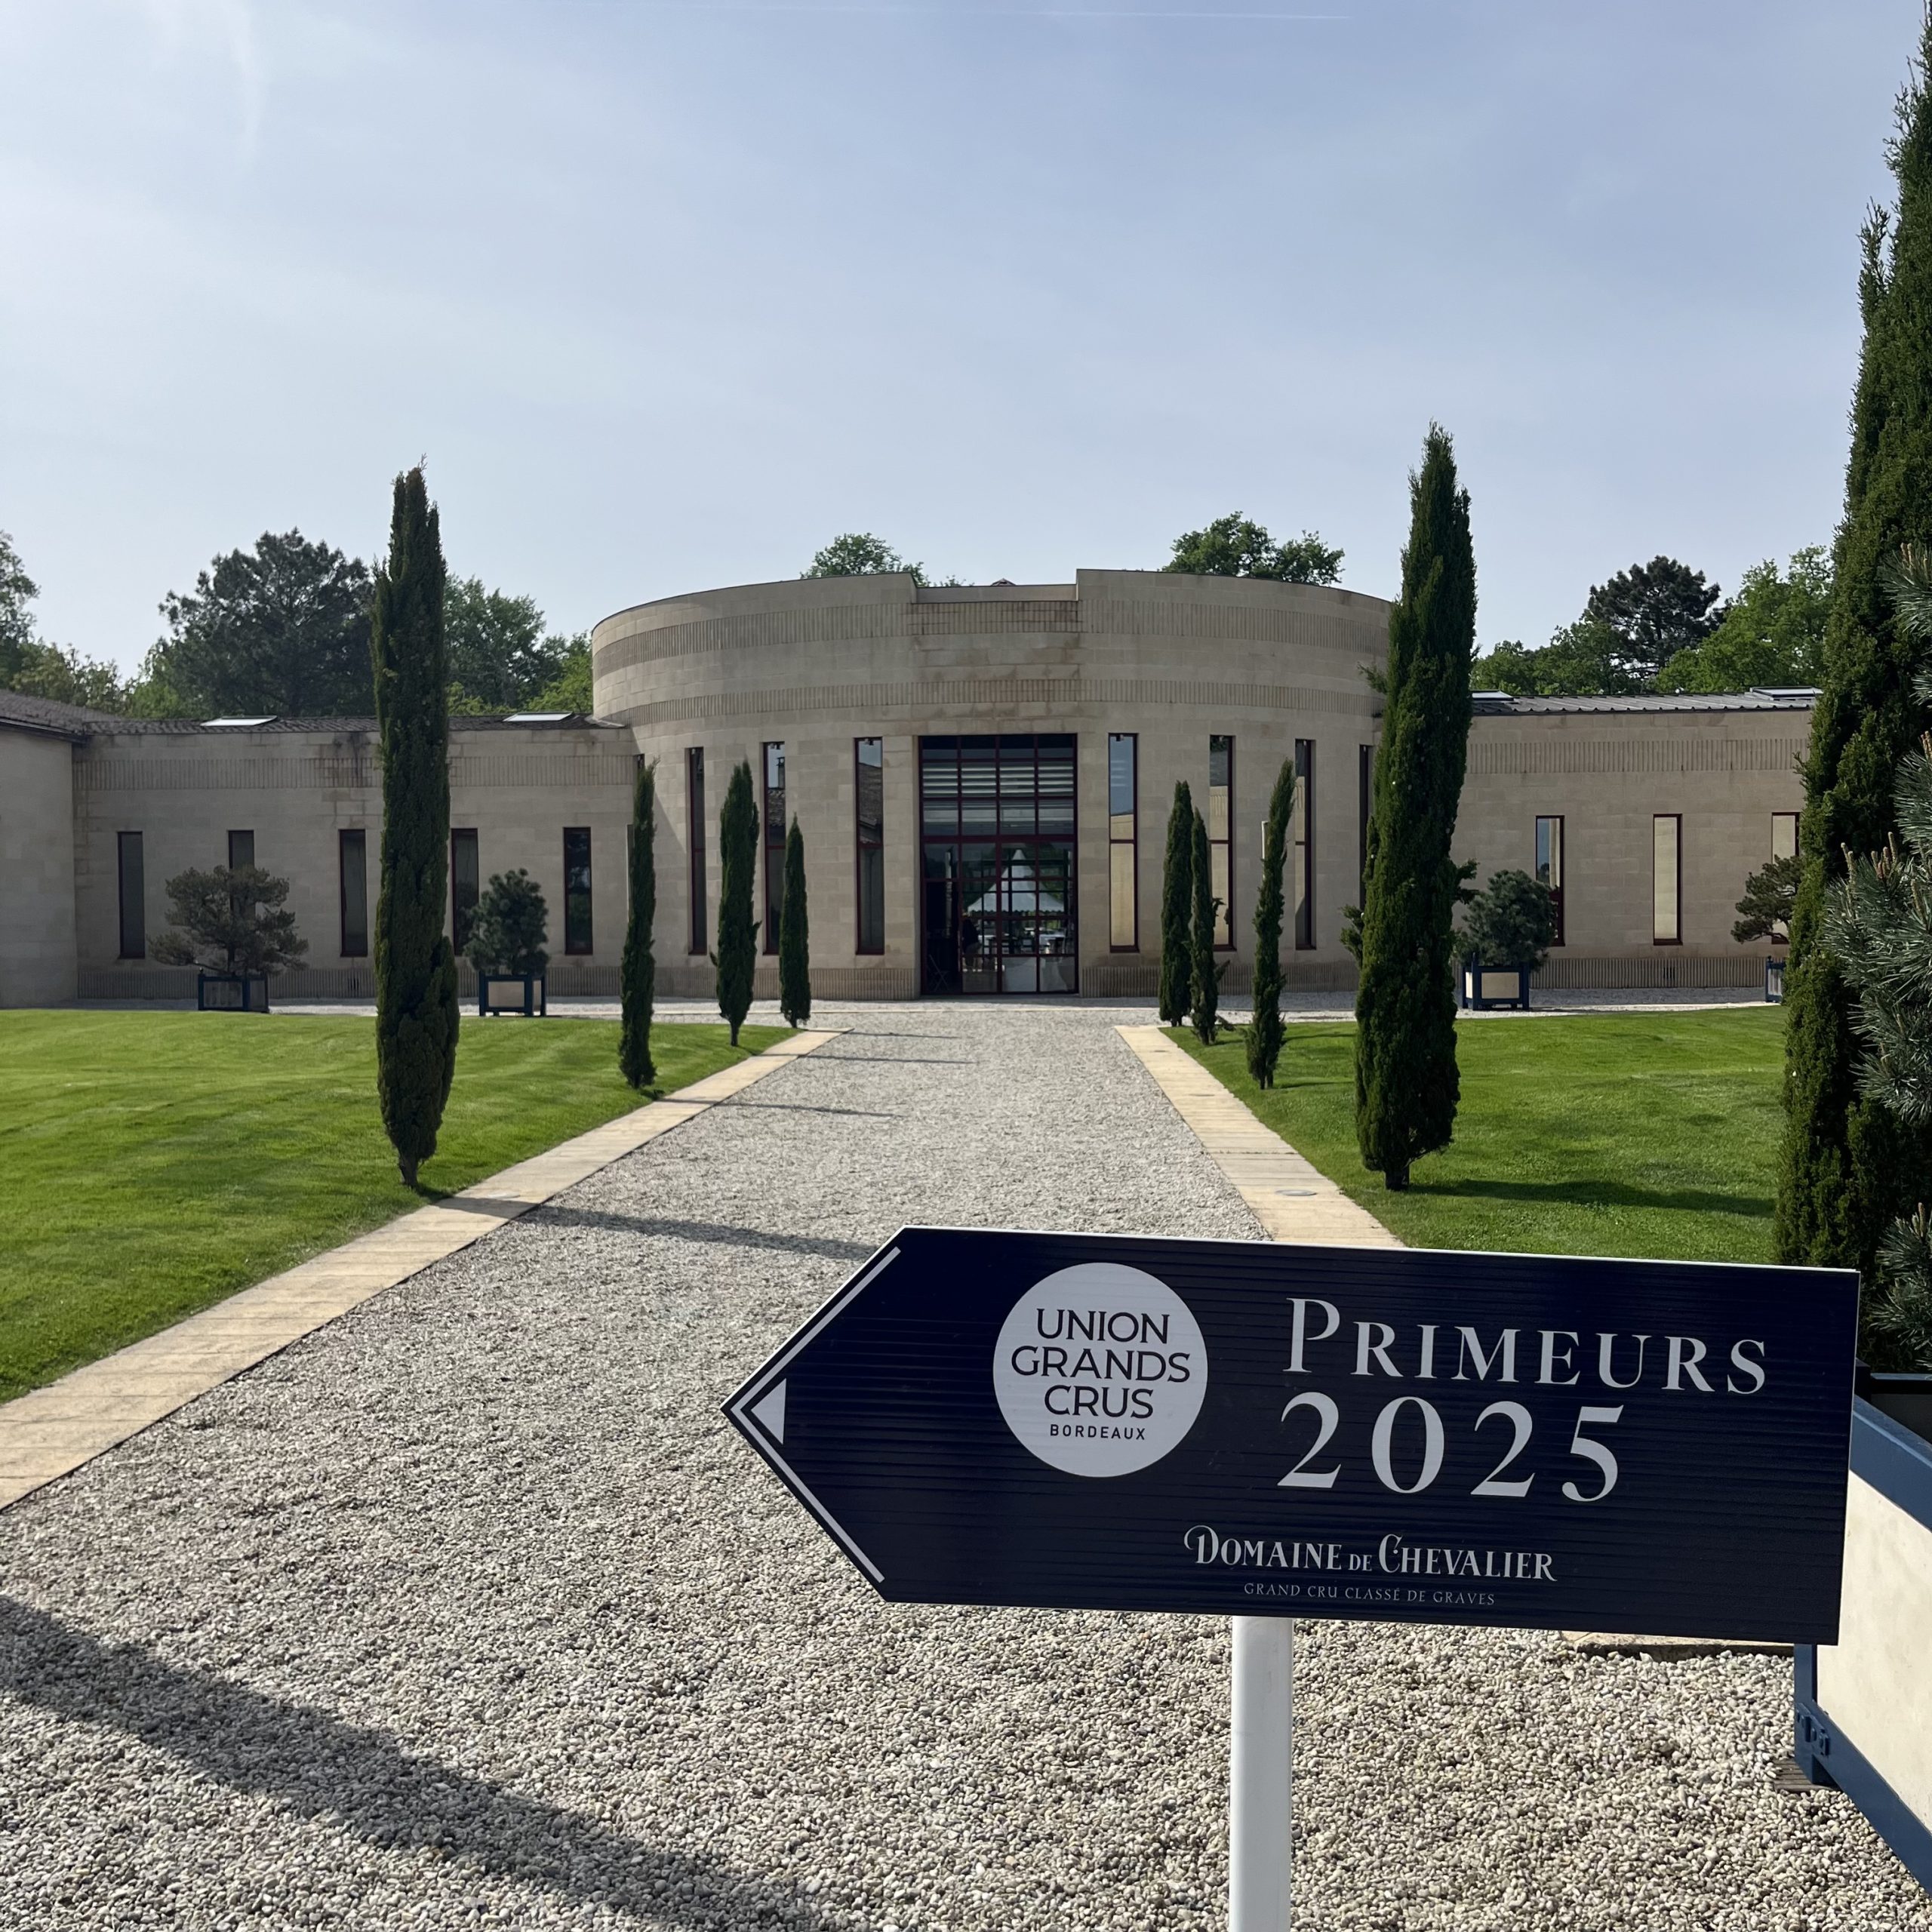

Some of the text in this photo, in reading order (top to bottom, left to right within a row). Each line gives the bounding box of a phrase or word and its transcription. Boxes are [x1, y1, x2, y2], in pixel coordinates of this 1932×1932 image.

[1036, 1308, 1170, 1344] UNION
[1283, 1297, 1766, 1394] PRIMEURS
[1011, 1346, 1190, 1383] GRANDS
[1044, 1385, 1154, 1419] CRUS
[1050, 1424, 1146, 1440] BORDEAUX
[1277, 1392, 1624, 1502] 2025
[1183, 1524, 1558, 1582] DOMAINE DE CHEVALIER
[1244, 1583, 1300, 1597] GRAND
[1307, 1586, 1338, 1598] CRU
[1407, 1590, 1426, 1602] DE
[1433, 1592, 1495, 1606] GRAVES
